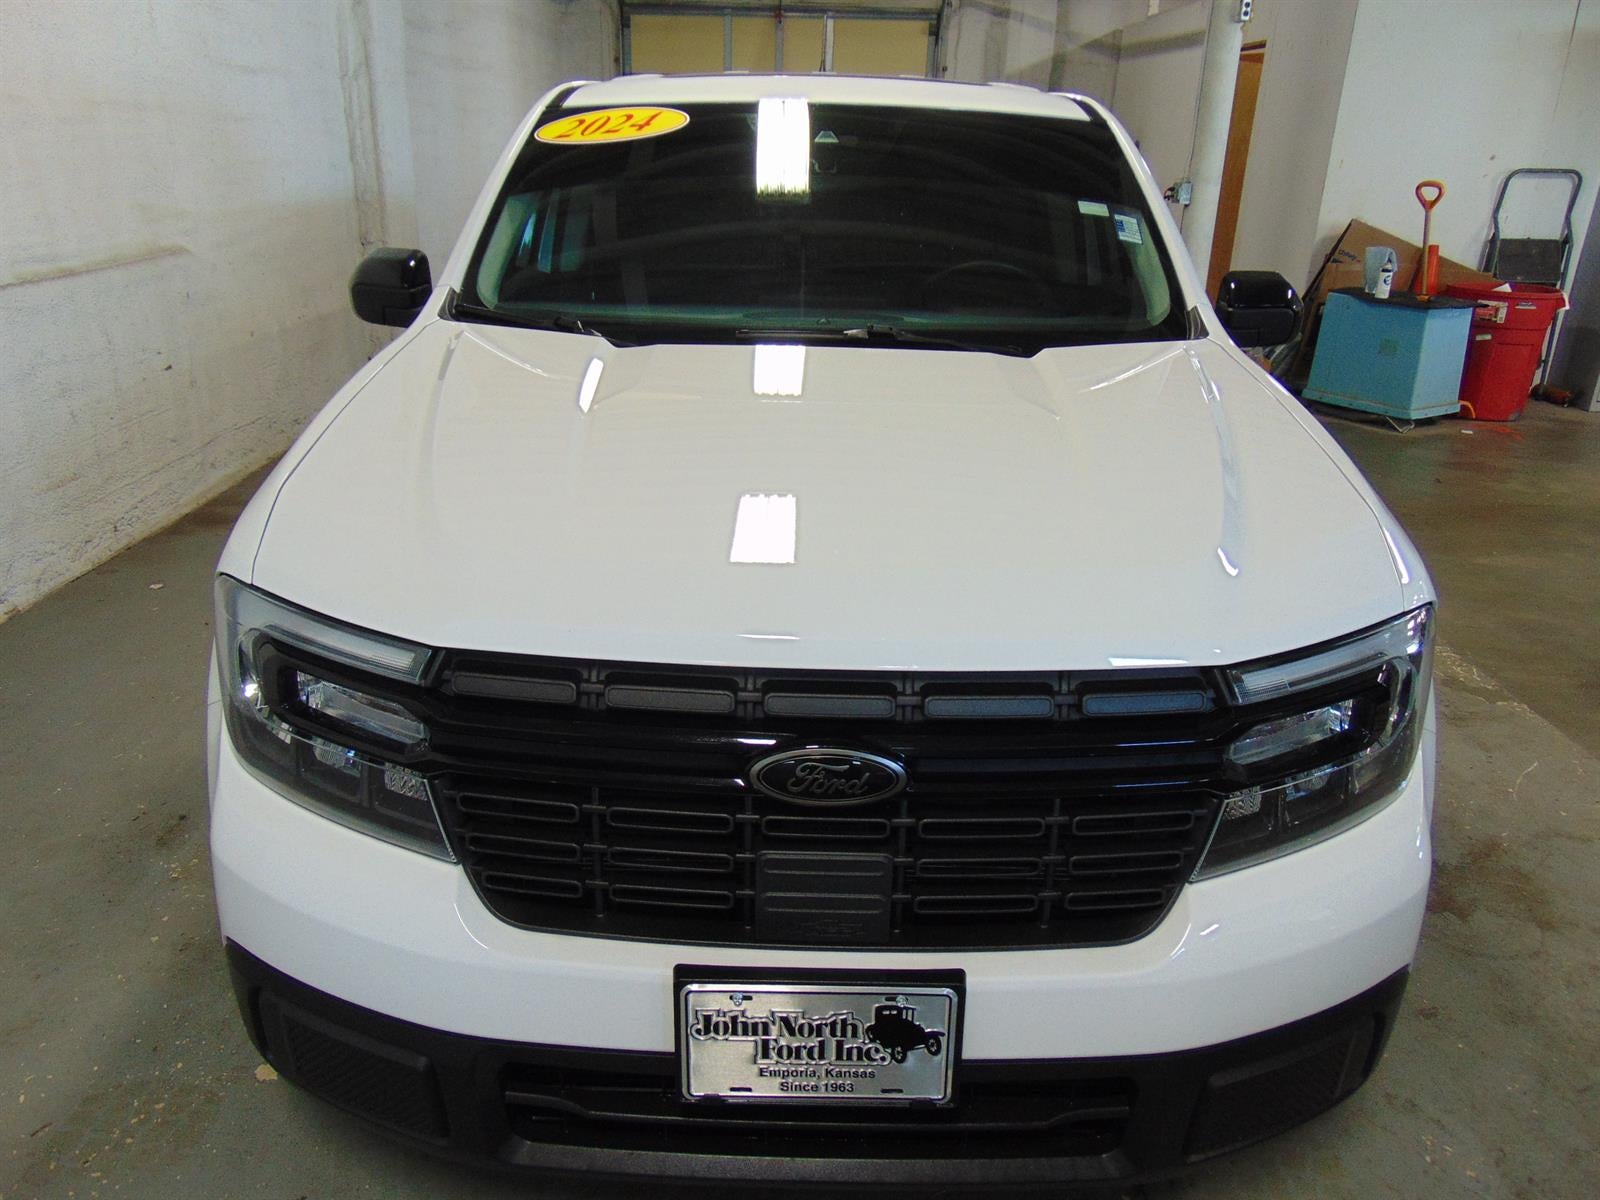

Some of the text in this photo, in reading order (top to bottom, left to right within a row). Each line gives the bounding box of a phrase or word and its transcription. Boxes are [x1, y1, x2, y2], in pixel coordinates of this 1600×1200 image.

[552, 111, 663, 140] 2024
[787, 761, 871, 794] Ford
[693, 1011, 866, 1040] John North
[758, 1038, 888, 1063] Ford Inc.
[759, 1066, 876, 1081] Emporia, Kansas
[779, 1081, 855, 1094] Since 1963
